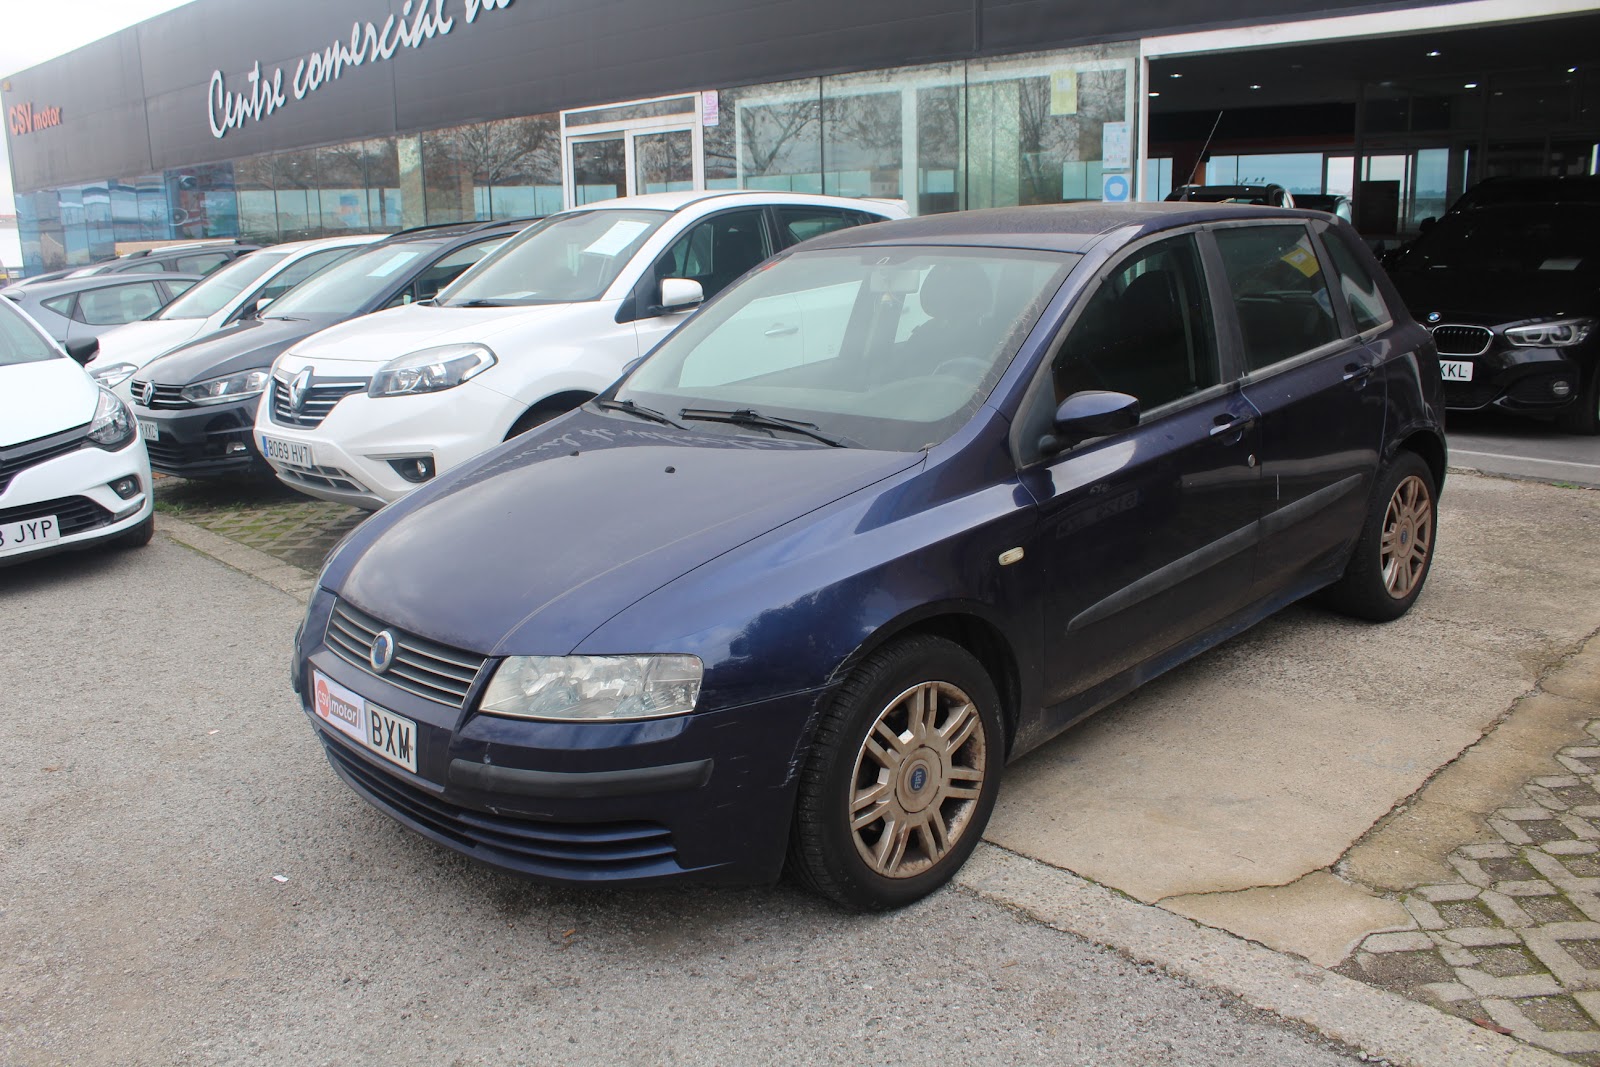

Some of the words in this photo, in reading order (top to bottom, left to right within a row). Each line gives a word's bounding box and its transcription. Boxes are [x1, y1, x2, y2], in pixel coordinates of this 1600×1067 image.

[208, 60, 285, 138] Centre
[293, 0, 453, 100] comercial
[9, 101, 33, 136] CSV
[33, 105, 61, 131] motor
[268, 440, 289, 460] 8069
[291, 443, 309, 465] HVT
[14, 520, 52, 543] JYP
[331, 699, 357, 723] motor
[371, 709, 411, 763] BXM
